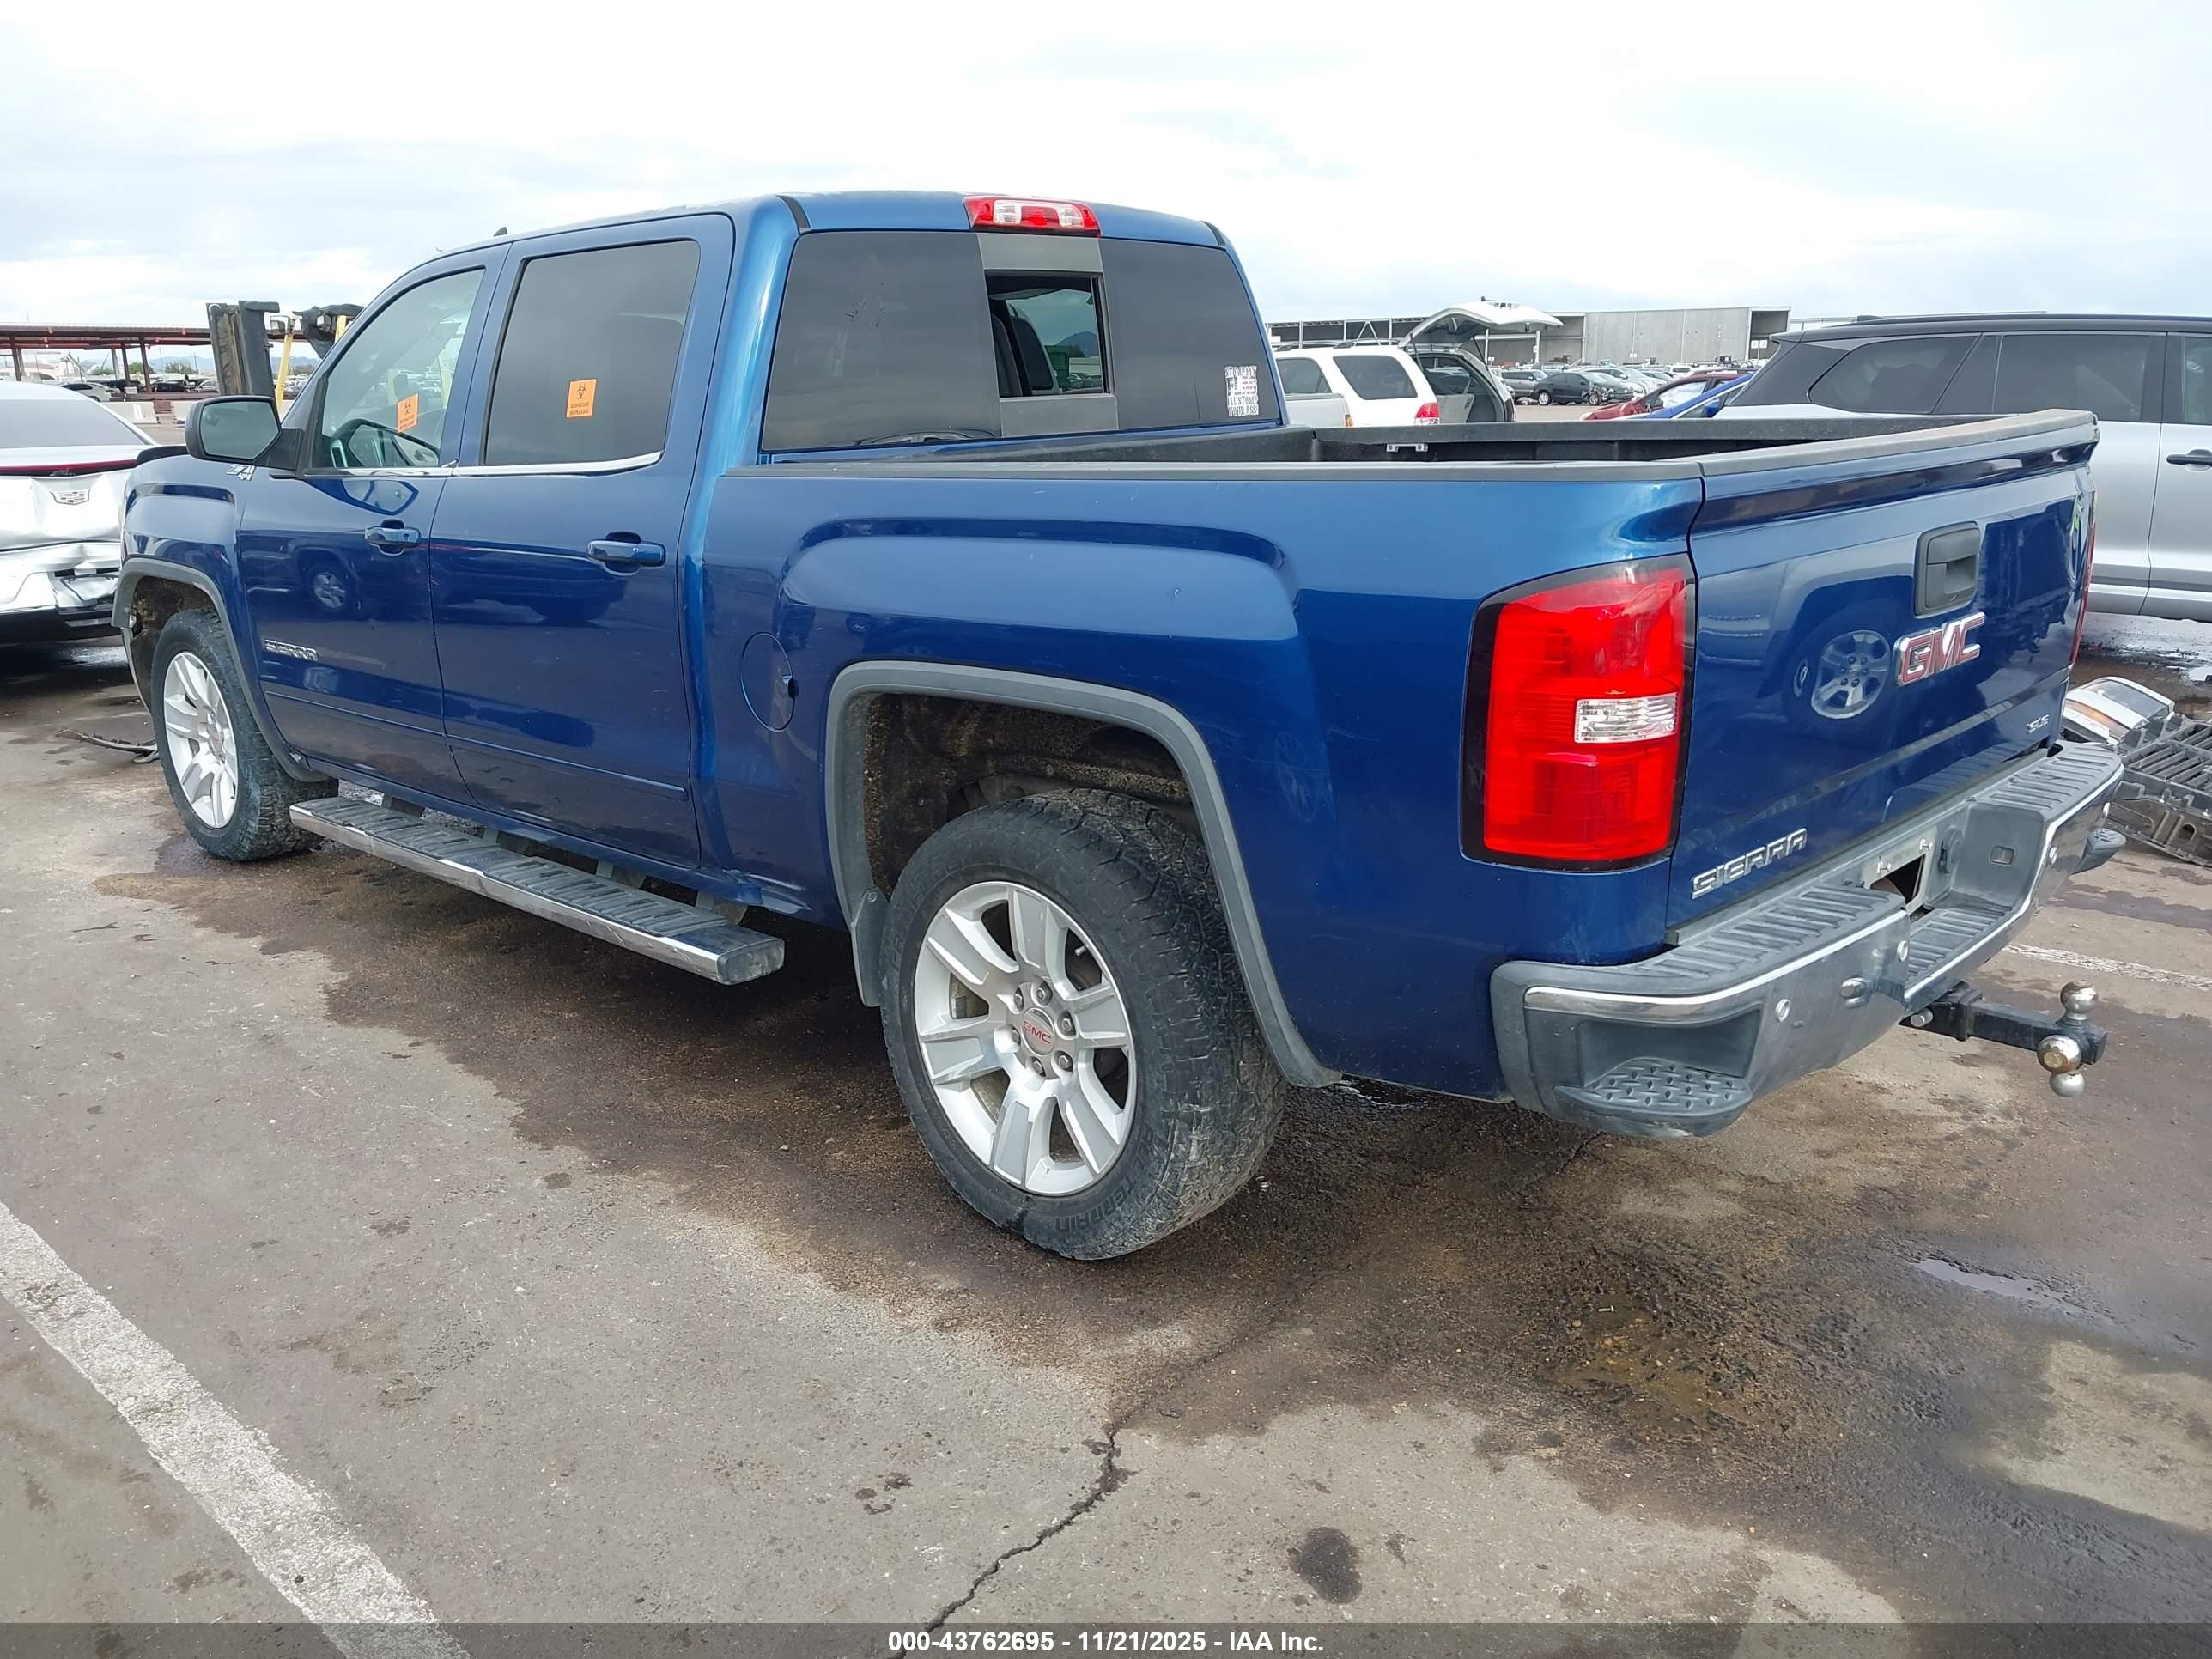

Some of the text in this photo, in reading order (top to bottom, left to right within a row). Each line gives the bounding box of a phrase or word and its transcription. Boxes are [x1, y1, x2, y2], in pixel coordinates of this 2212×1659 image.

[264, 639, 318, 661] SIERRA
[1893, 611, 1987, 686] GMC
[1691, 827, 1808, 900] SIERRA
[1023, 1020, 1052, 1044] GMC
